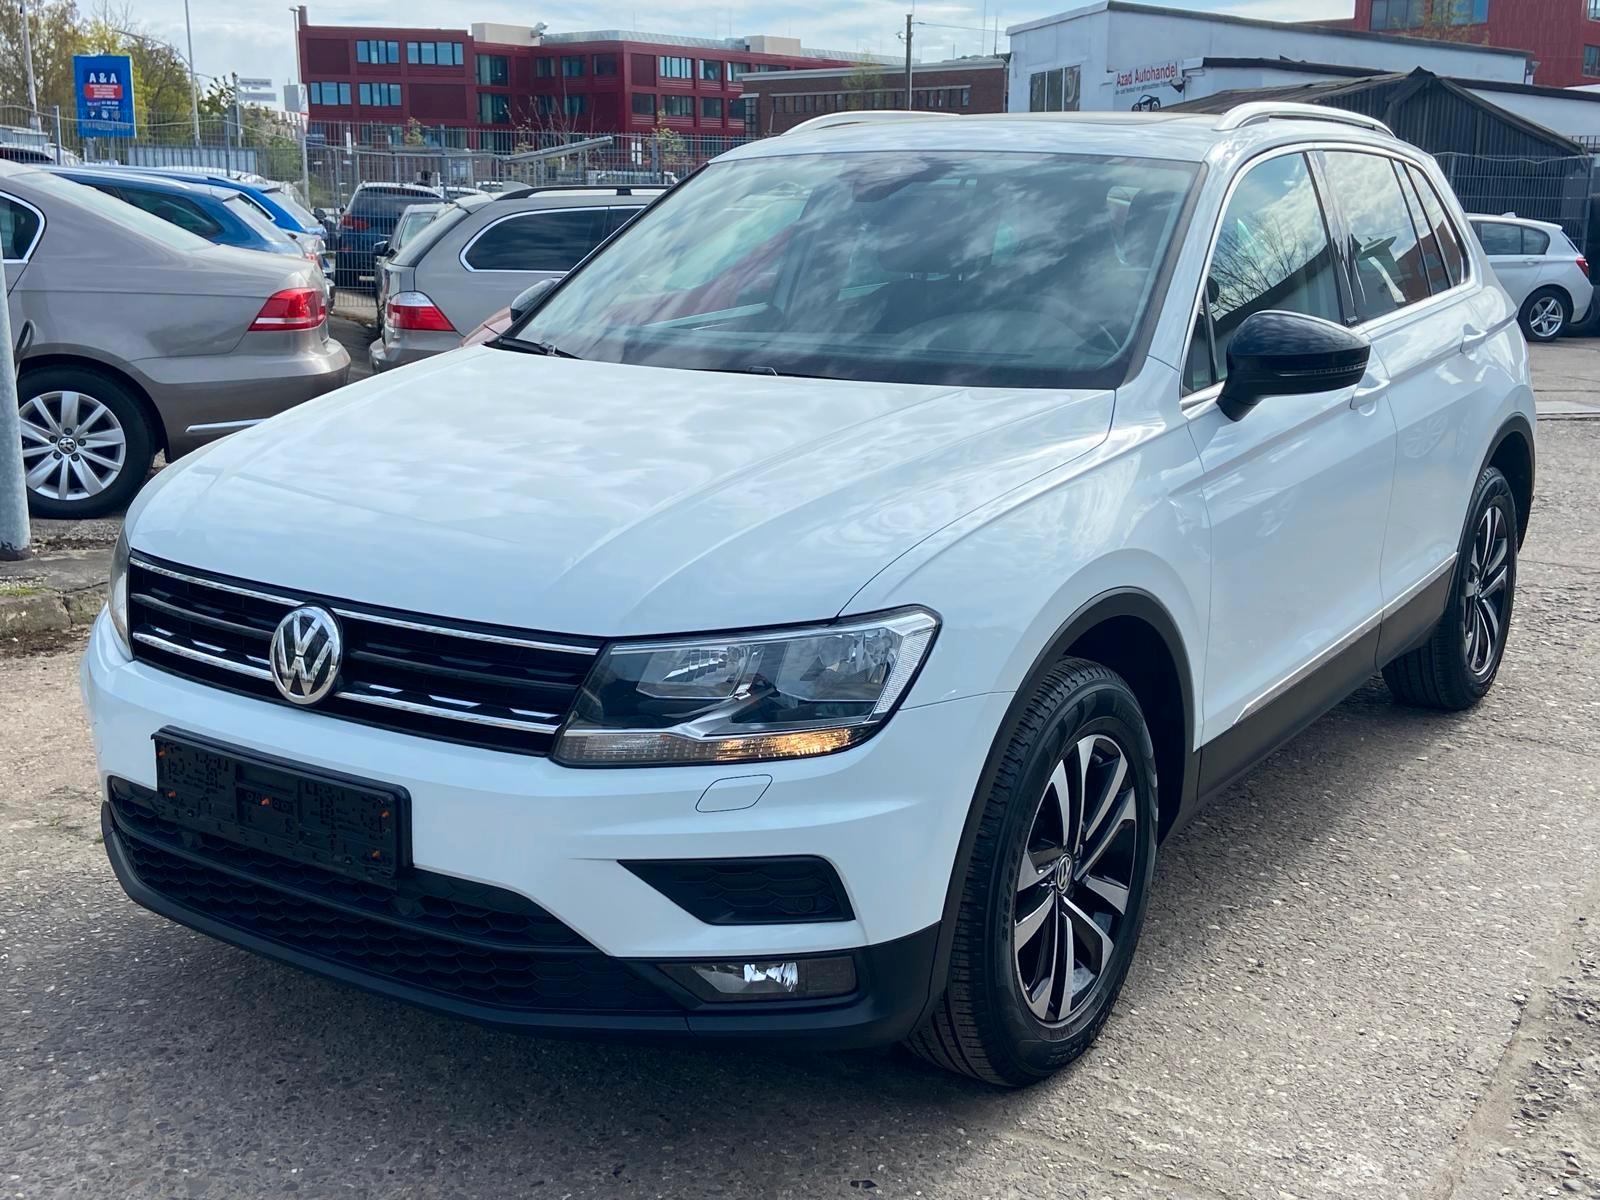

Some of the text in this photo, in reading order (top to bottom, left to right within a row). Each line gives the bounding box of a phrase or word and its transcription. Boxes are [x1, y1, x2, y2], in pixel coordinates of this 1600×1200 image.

[89, 72, 118, 84] A & A
[1116, 61, 1178, 87] Azad Autohandel
[272, 607, 339, 703] VW
